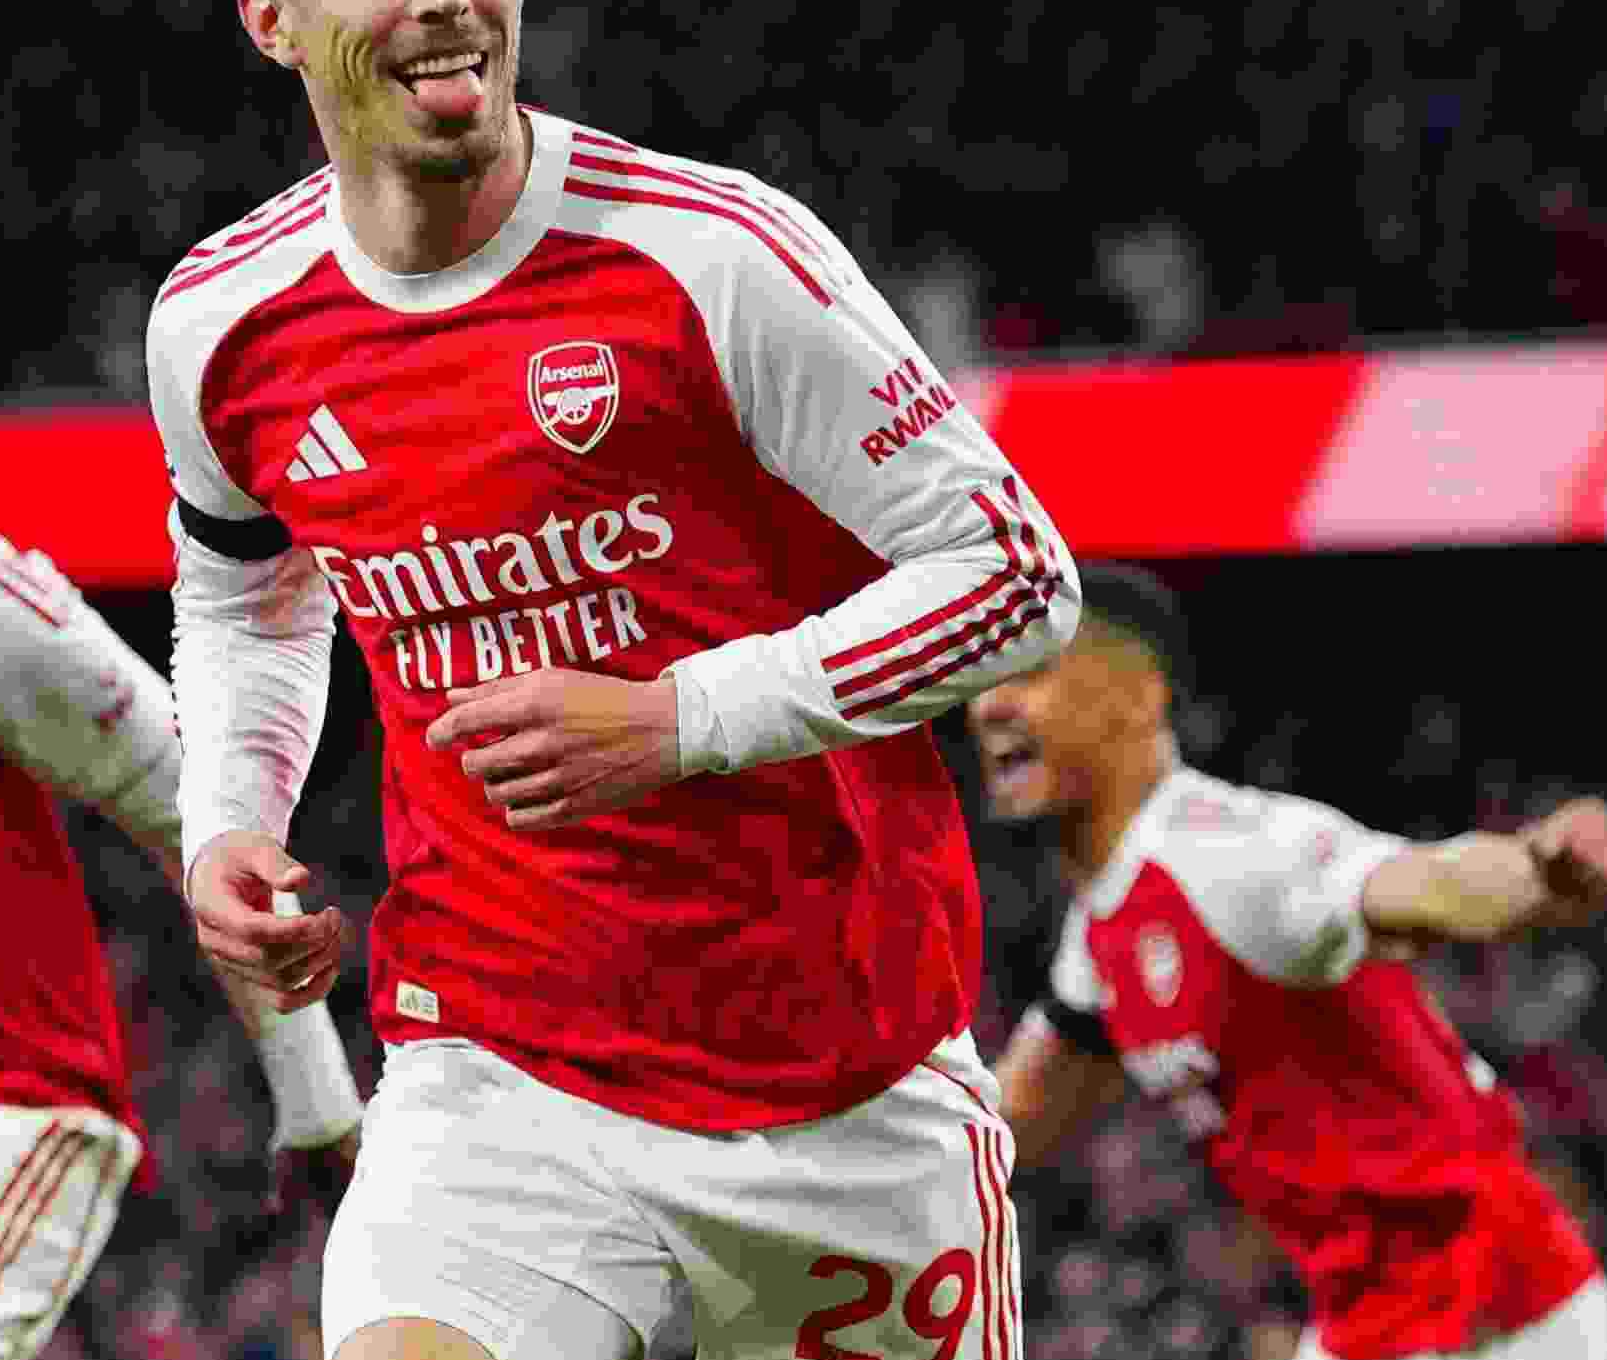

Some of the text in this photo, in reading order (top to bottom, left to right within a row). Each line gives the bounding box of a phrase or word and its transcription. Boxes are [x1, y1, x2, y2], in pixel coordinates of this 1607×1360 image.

[311, 492, 674, 623] Emirates
[389, 586, 648, 690] FLY BETTER
